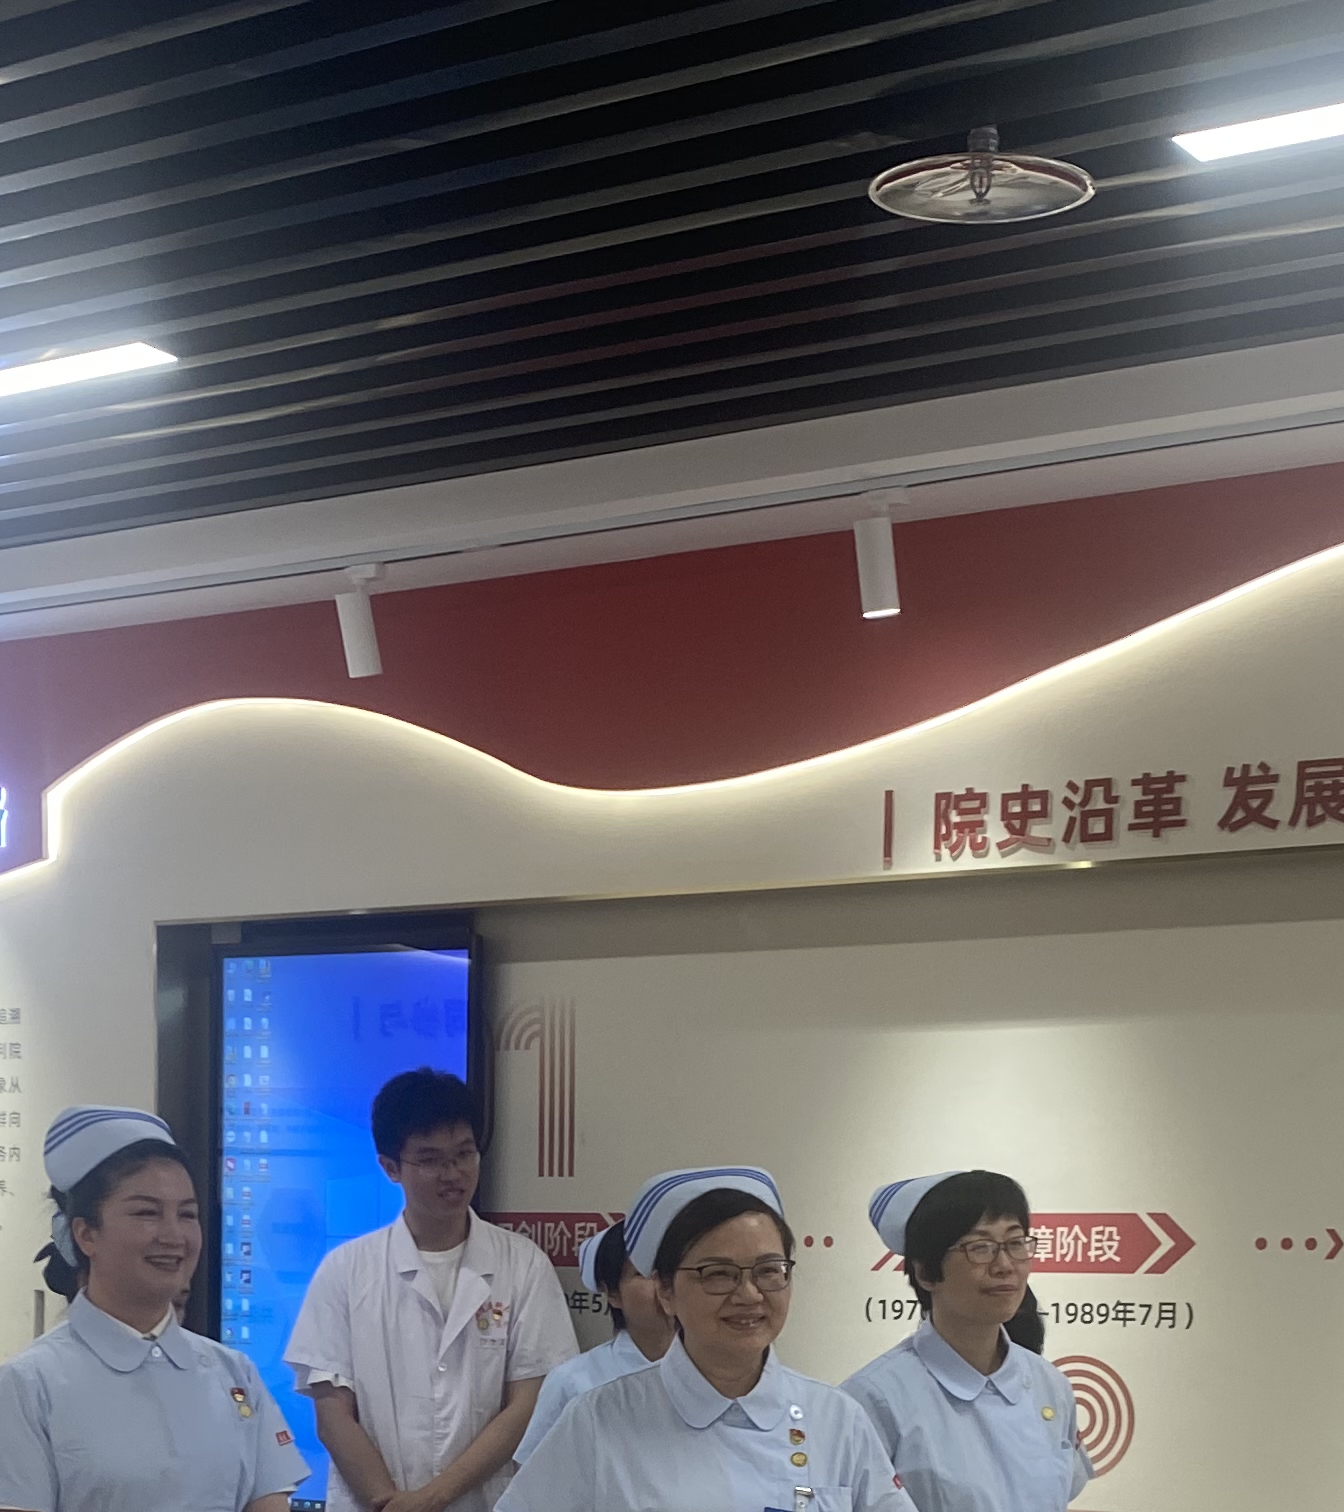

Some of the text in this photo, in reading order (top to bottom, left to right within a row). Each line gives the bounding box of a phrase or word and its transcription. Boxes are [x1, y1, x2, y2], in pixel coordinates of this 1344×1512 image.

[933, 770, 1188, 861] 院史沿革
[499, 1221, 598, 1257] 创阶段
